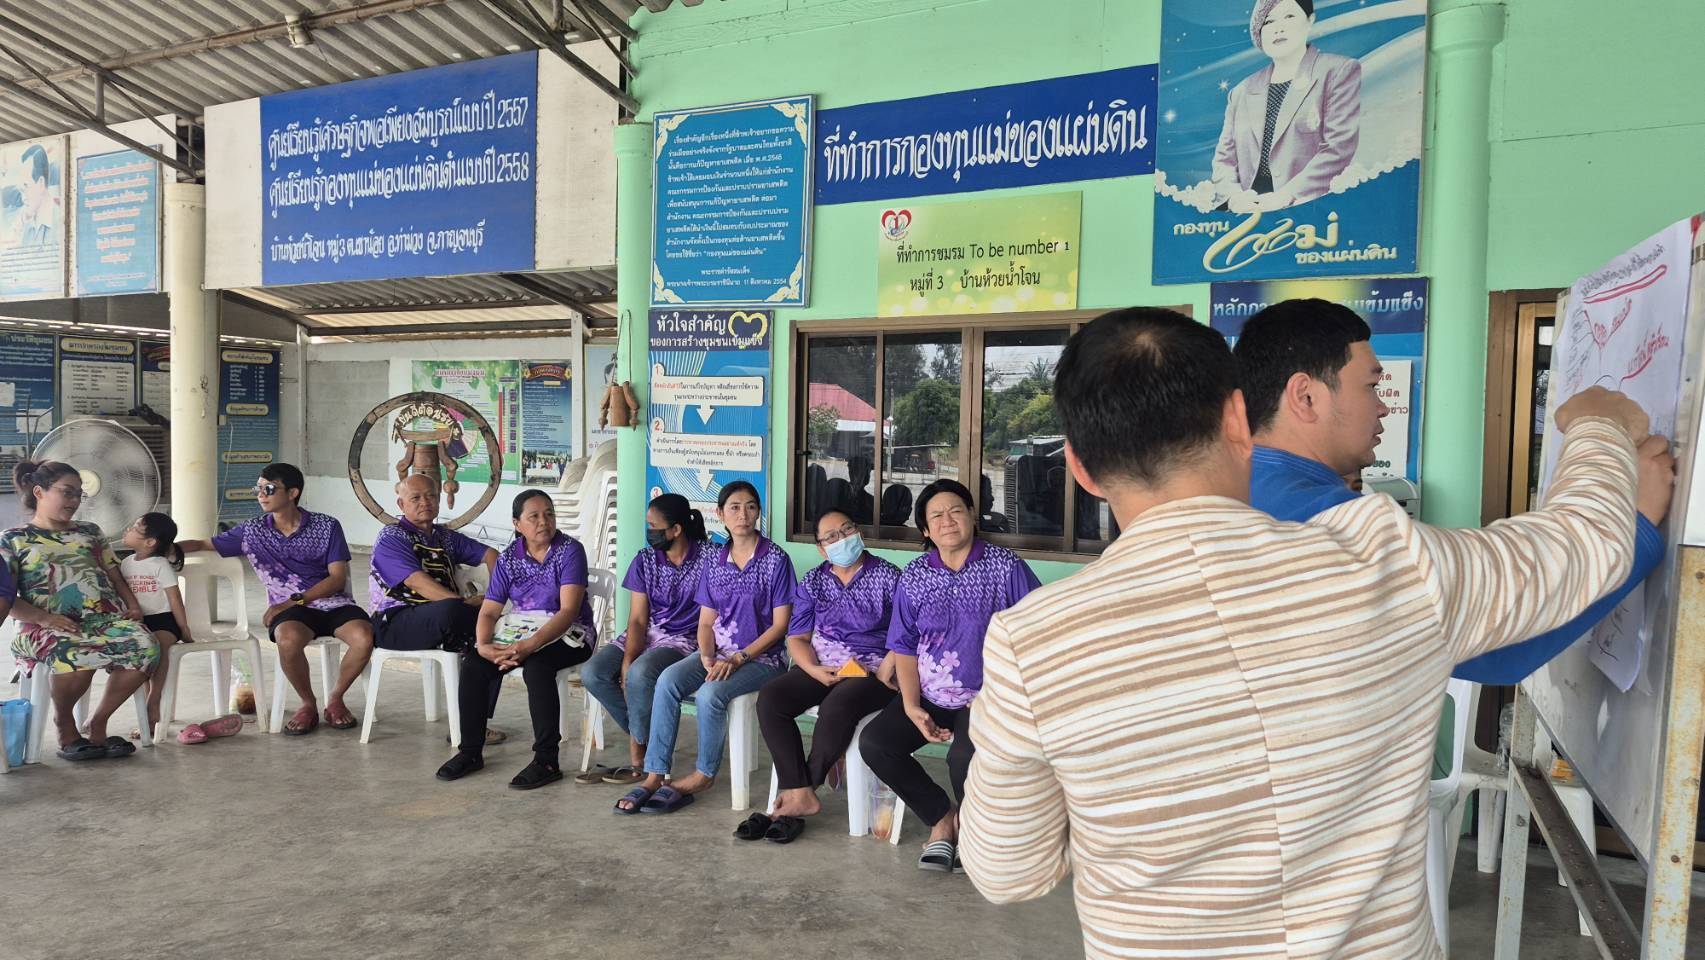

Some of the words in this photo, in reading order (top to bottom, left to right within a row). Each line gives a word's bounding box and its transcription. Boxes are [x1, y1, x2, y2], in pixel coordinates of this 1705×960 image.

[497, 96, 529, 129] 2557
[824, 99, 1148, 183] ที่ทำการกองทุนแม่ของแผ่นดิน
[497, 152, 529, 183] 2558
[1173, 220, 1231, 238] กองทุน
[896, 241, 965, 263] ที่ทำการชมรม
[970, 243, 985, 259] To
[988, 241, 1004, 258] be
[1008, 239, 1059, 256] number
[1064, 242, 1071, 251] 1
[1295, 239, 1398, 264] ของแผ่นดิน
[909, 267, 934, 297] หมู่ที่
[937, 275, 944, 290] 3
[960, 260, 1041, 290] บ้านห้วยน้ำโจน
[656, 311, 726, 335] หัวใจสำคัญ
